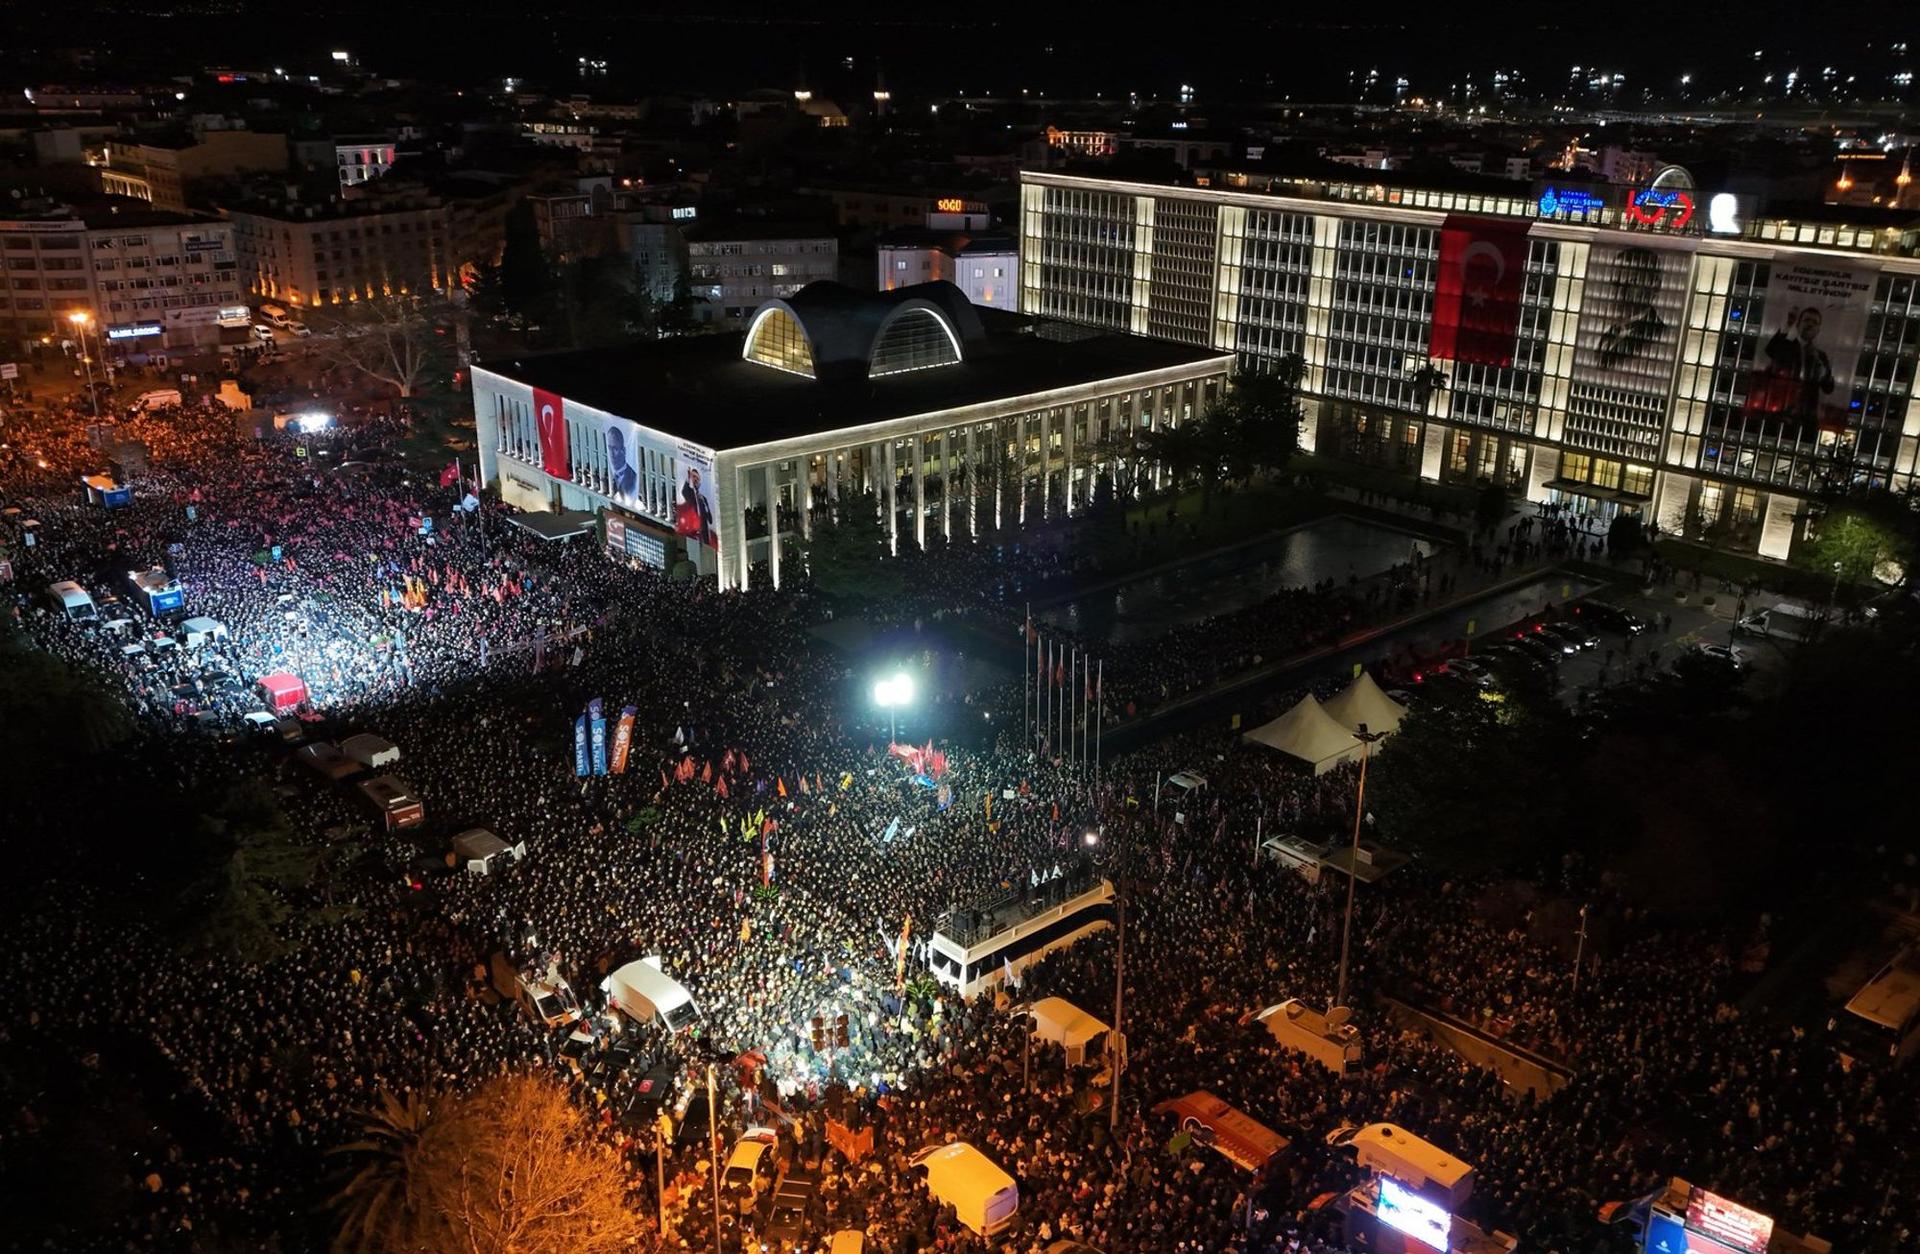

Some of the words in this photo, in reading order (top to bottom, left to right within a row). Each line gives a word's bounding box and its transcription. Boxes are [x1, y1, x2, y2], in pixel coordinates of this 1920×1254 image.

[576, 725, 585, 749] SOL
[592, 727, 603, 749] SOL
[615, 724, 630, 746] SOL
